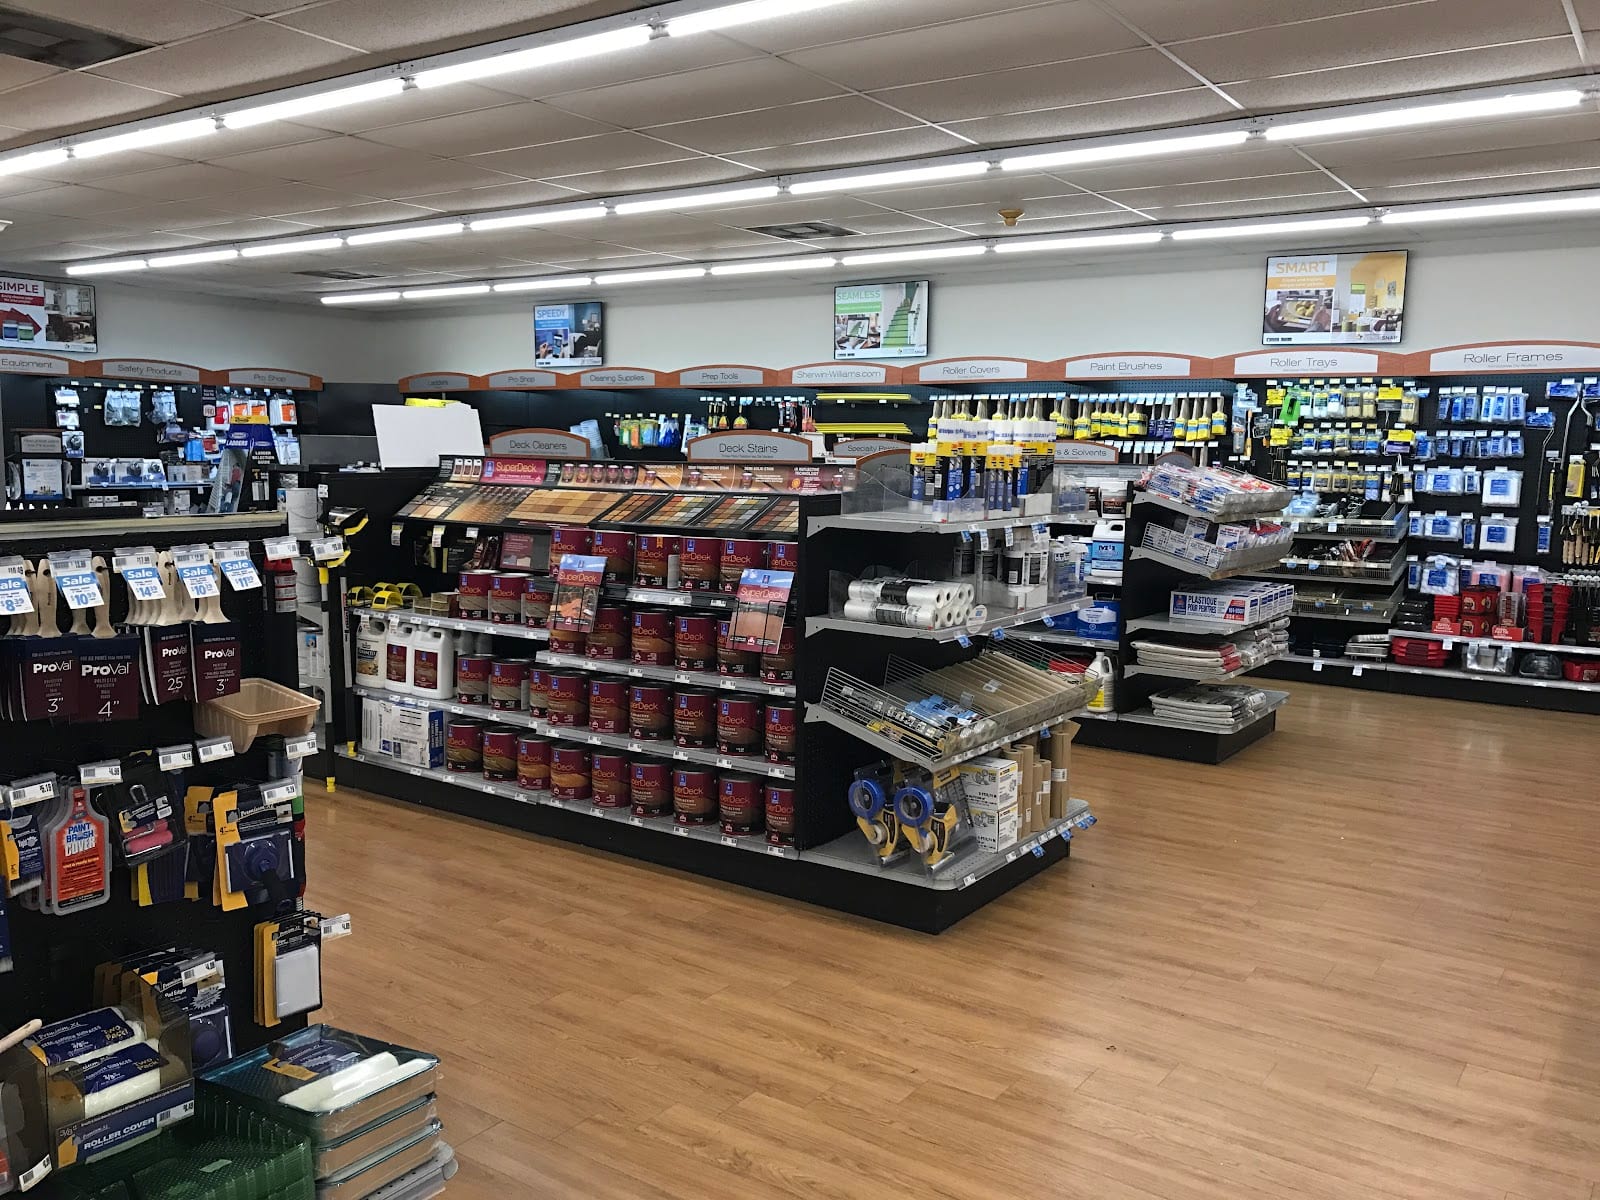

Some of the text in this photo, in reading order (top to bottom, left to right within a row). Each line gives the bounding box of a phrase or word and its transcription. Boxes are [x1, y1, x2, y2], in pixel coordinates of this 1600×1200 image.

[1275, 260, 1328, 274] SMART
[836, 289, 880, 300] SEAMLESS
[537, 308, 566, 318] SPEEDY
[1463, 351, 1563, 364] Roller Frames
[1, 358, 53, 369] Equipment
[1090, 361, 1163, 371] Paint Brushes
[1269, 357, 1338, 370] Roller Trays
[117, 364, 183, 377] Safety Products
[796, 369, 881, 379] Sherwin-Williams.com
[942, 365, 1001, 375] Roller Covers
[267, 375, 286, 383] Shop
[519, 375, 536, 383] Shop
[589, 374, 645, 383] Cleaning Supplies
[702, 372, 739, 382] Prep Tools
[509, 440, 568, 450] Deck Cleaners
[719, 443, 778, 453] Deck Stains
[847, 444, 878, 453] Specialty
[1063, 448, 1070, 456] &
[1071, 448, 1107, 457] Solvents
[496, 462, 537, 473] SuperDeck
[184, 567, 208, 577] Sale
[224, 562, 249, 571] Sale
[127, 569, 153, 579] Sale
[559, 571, 598, 583] SuperDeck
[0, 579, 21, 590] ale
[62, 575, 92, 586] Sale
[741, 588, 785, 600] SuperDeck
[1188, 595, 1217, 606] PLASTIQUE
[162, 645, 188, 658] ProVal
[204, 647, 236, 660] ProVal
[33, 660, 73, 674] ProVal
[81, 662, 130, 677] ProVal
[47, 697, 64, 713] 3"
[97, 700, 120, 718] 4"
[68, 822, 91, 835] PAINT
[65, 837, 97, 857] COVER
[83, 1117, 155, 1150] ROLLER COVER
